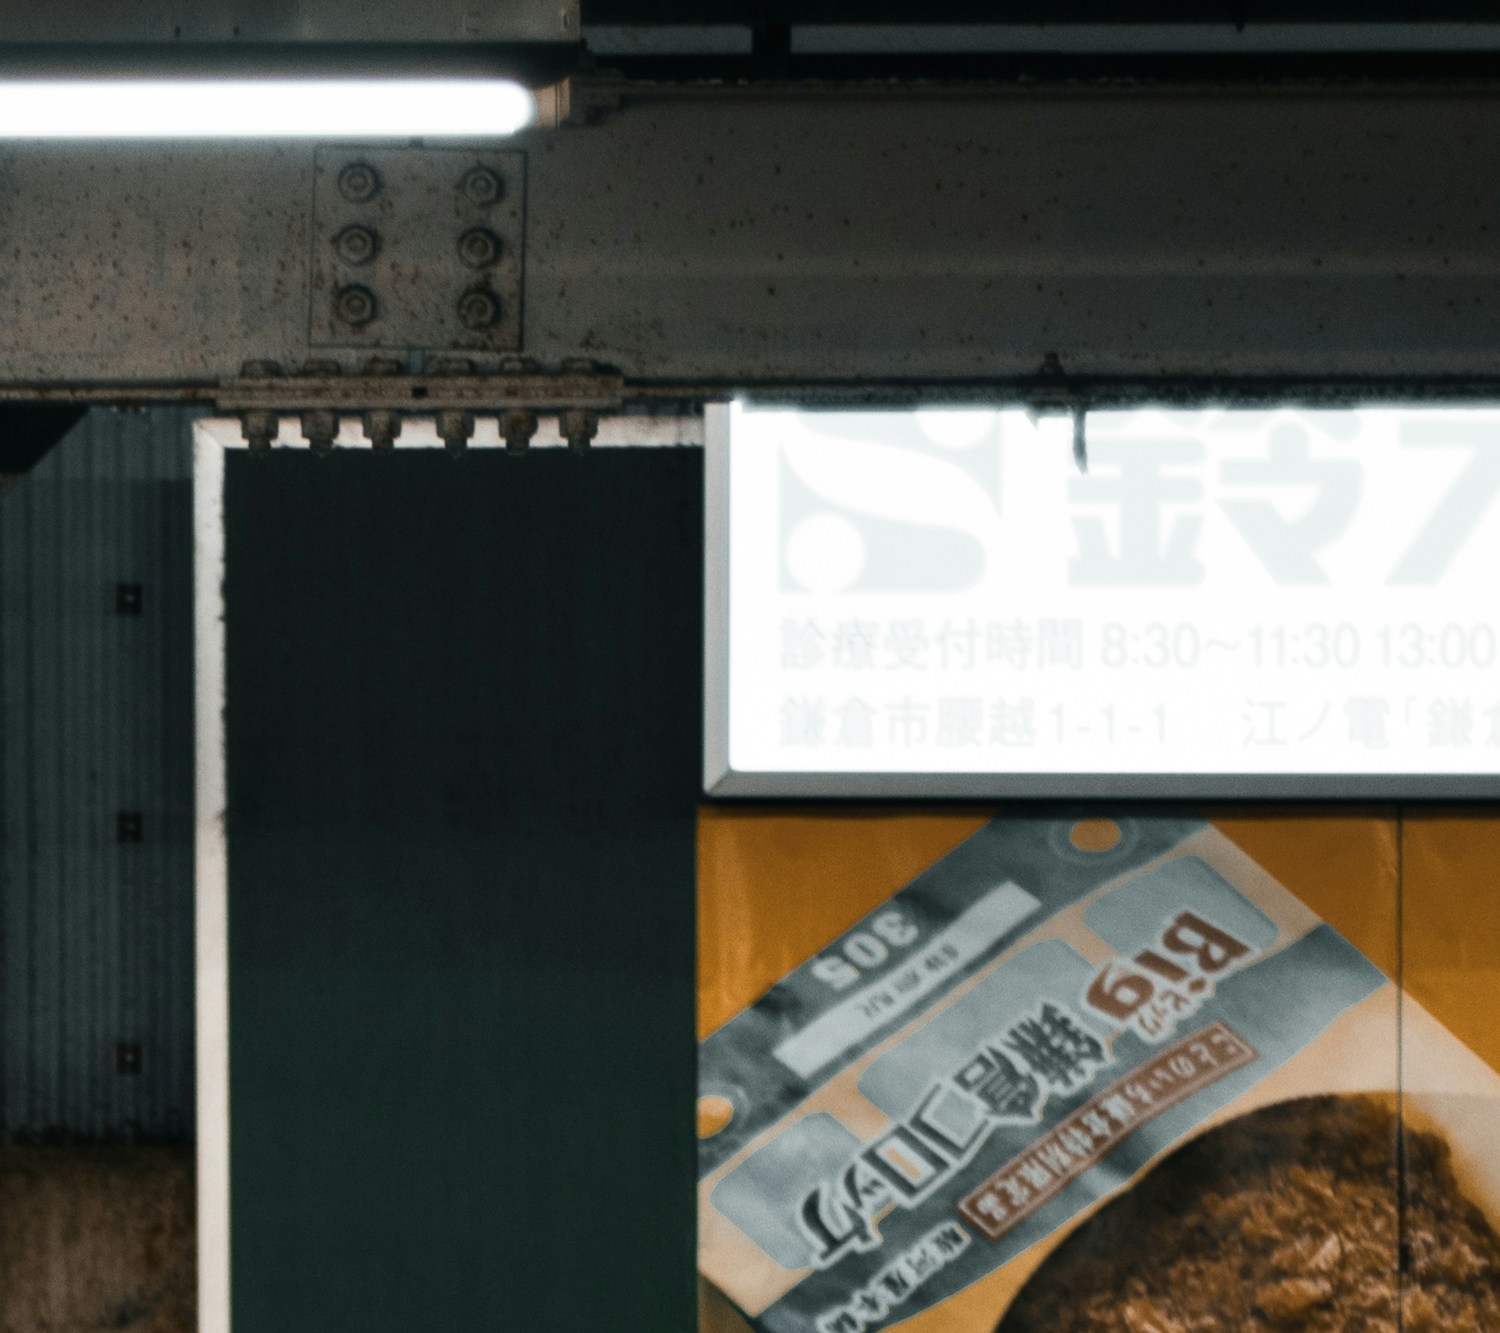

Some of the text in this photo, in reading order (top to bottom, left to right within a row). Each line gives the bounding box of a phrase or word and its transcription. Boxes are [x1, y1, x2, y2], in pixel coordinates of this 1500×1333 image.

[779, 617, 1083, 672] 診療受付時間
[1087, 911, 1252, 1022] Big
[800, 1001, 1108, 1261] 鎌倉コロッケ
